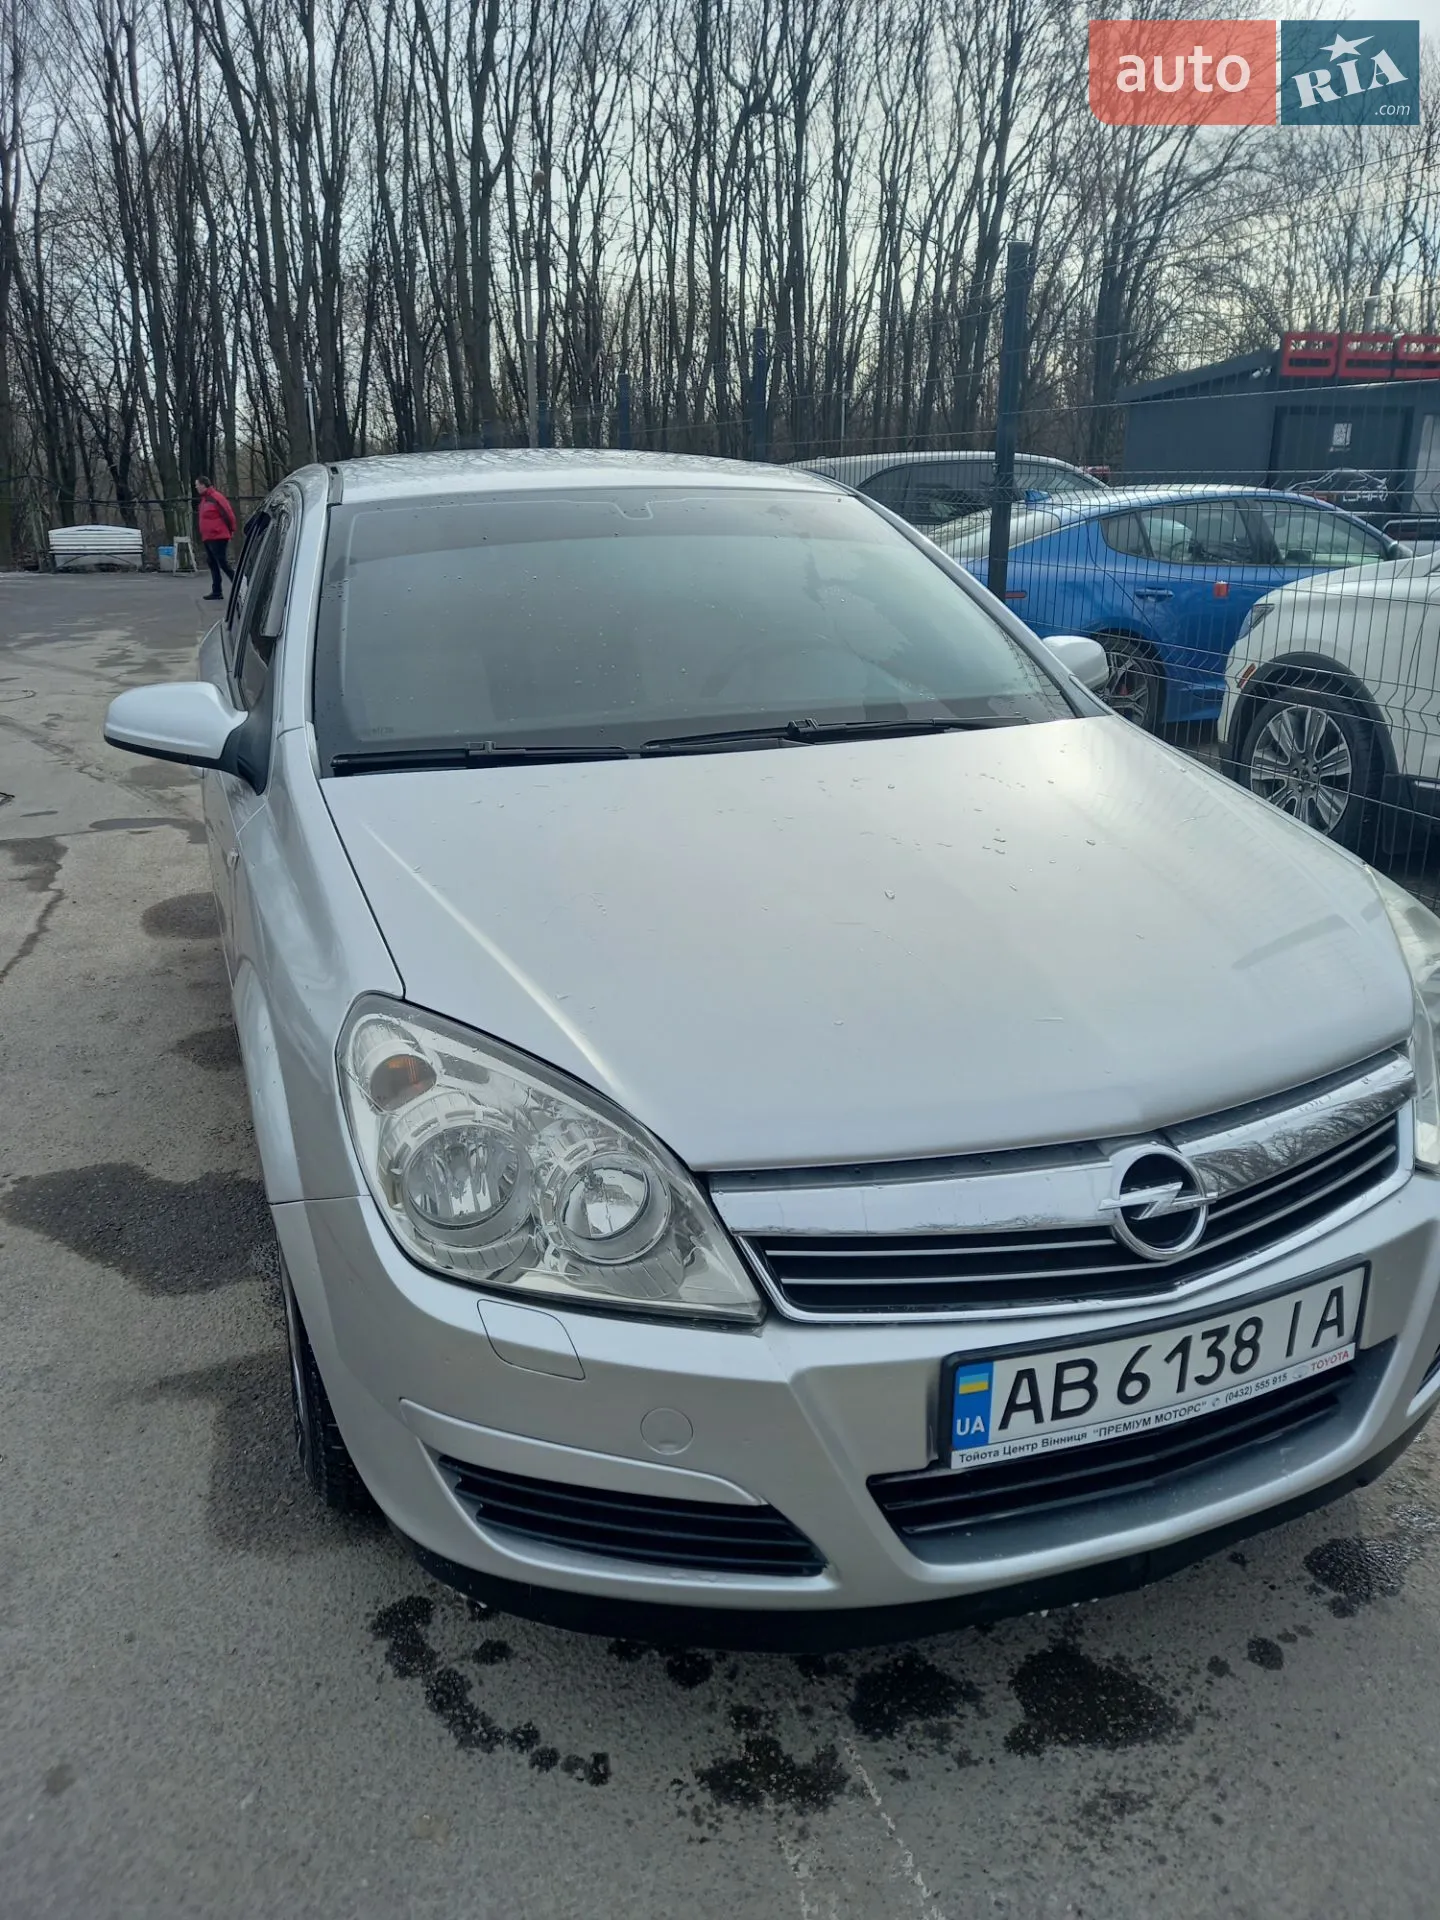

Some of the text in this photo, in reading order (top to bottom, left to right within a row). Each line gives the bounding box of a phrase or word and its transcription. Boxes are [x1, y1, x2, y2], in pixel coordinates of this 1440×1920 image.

[998, 1285, 1345, 1431] AB 6138 IA
[1311, 1350, 1349, 1371] TOYOTA
[956, 1415, 985, 1436] UA
[959, 1448, 1000, 1463] Тойота
[1003, 1442, 1038, 1457] Центр
[1041, 1432, 1087, 1448] Вінниця
[1225, 1385, 1252, 1404] (0432)
[1255, 1380, 1270, 1392] 555
